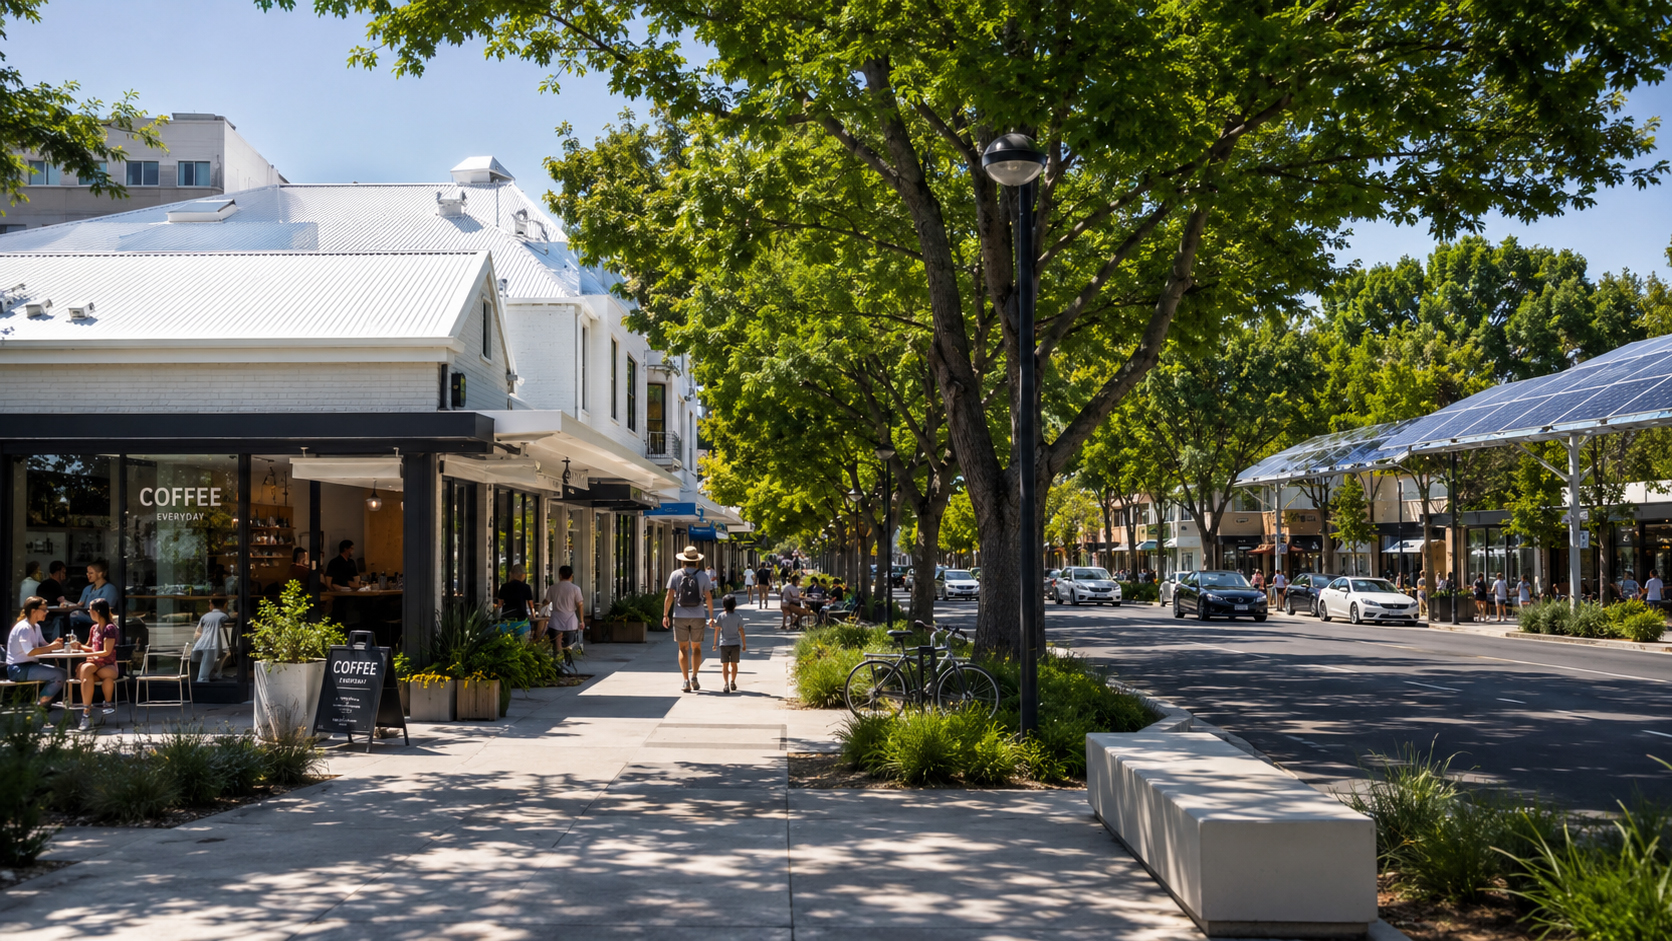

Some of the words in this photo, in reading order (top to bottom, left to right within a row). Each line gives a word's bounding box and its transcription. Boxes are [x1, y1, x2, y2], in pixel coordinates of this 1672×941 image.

[139, 487, 222, 507] COFFEE
[156, 512, 205, 521] EVERYDAY
[333, 660, 378, 675] COFFEE
